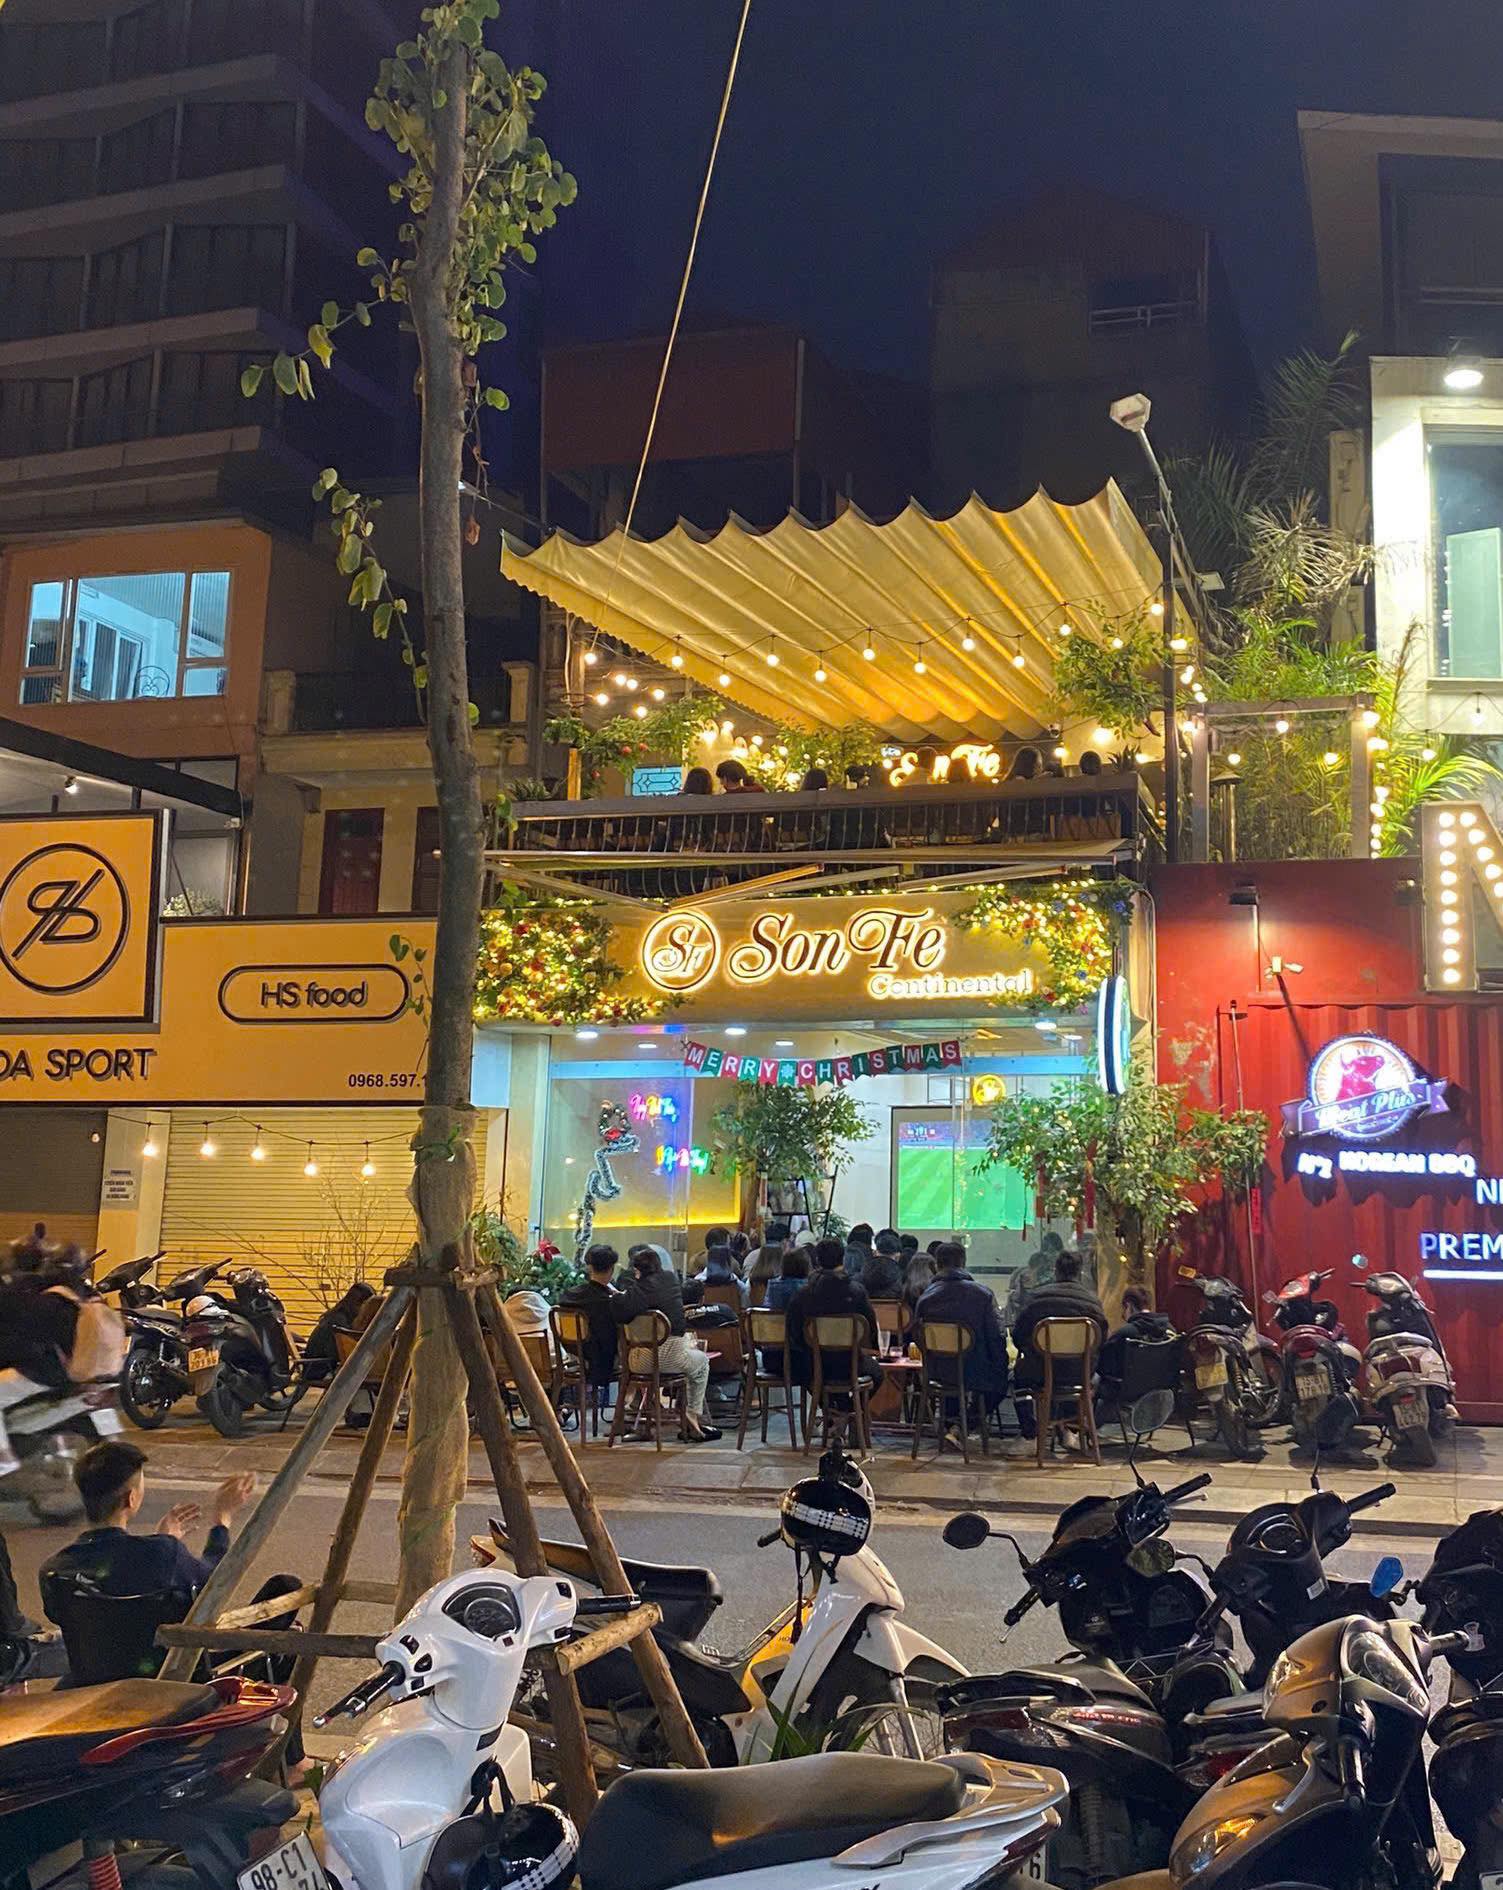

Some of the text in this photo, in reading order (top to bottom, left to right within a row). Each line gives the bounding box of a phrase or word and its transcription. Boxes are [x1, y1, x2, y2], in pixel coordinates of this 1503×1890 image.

[729, 909, 942, 979] Son Fe
[260, 980, 368, 1008] HS food
[869, 970, 1031, 996] Continental
[44, 1048, 157, 1081] SPORT
[687, 1043, 961, 1079] MERRY CHRISTMAS
